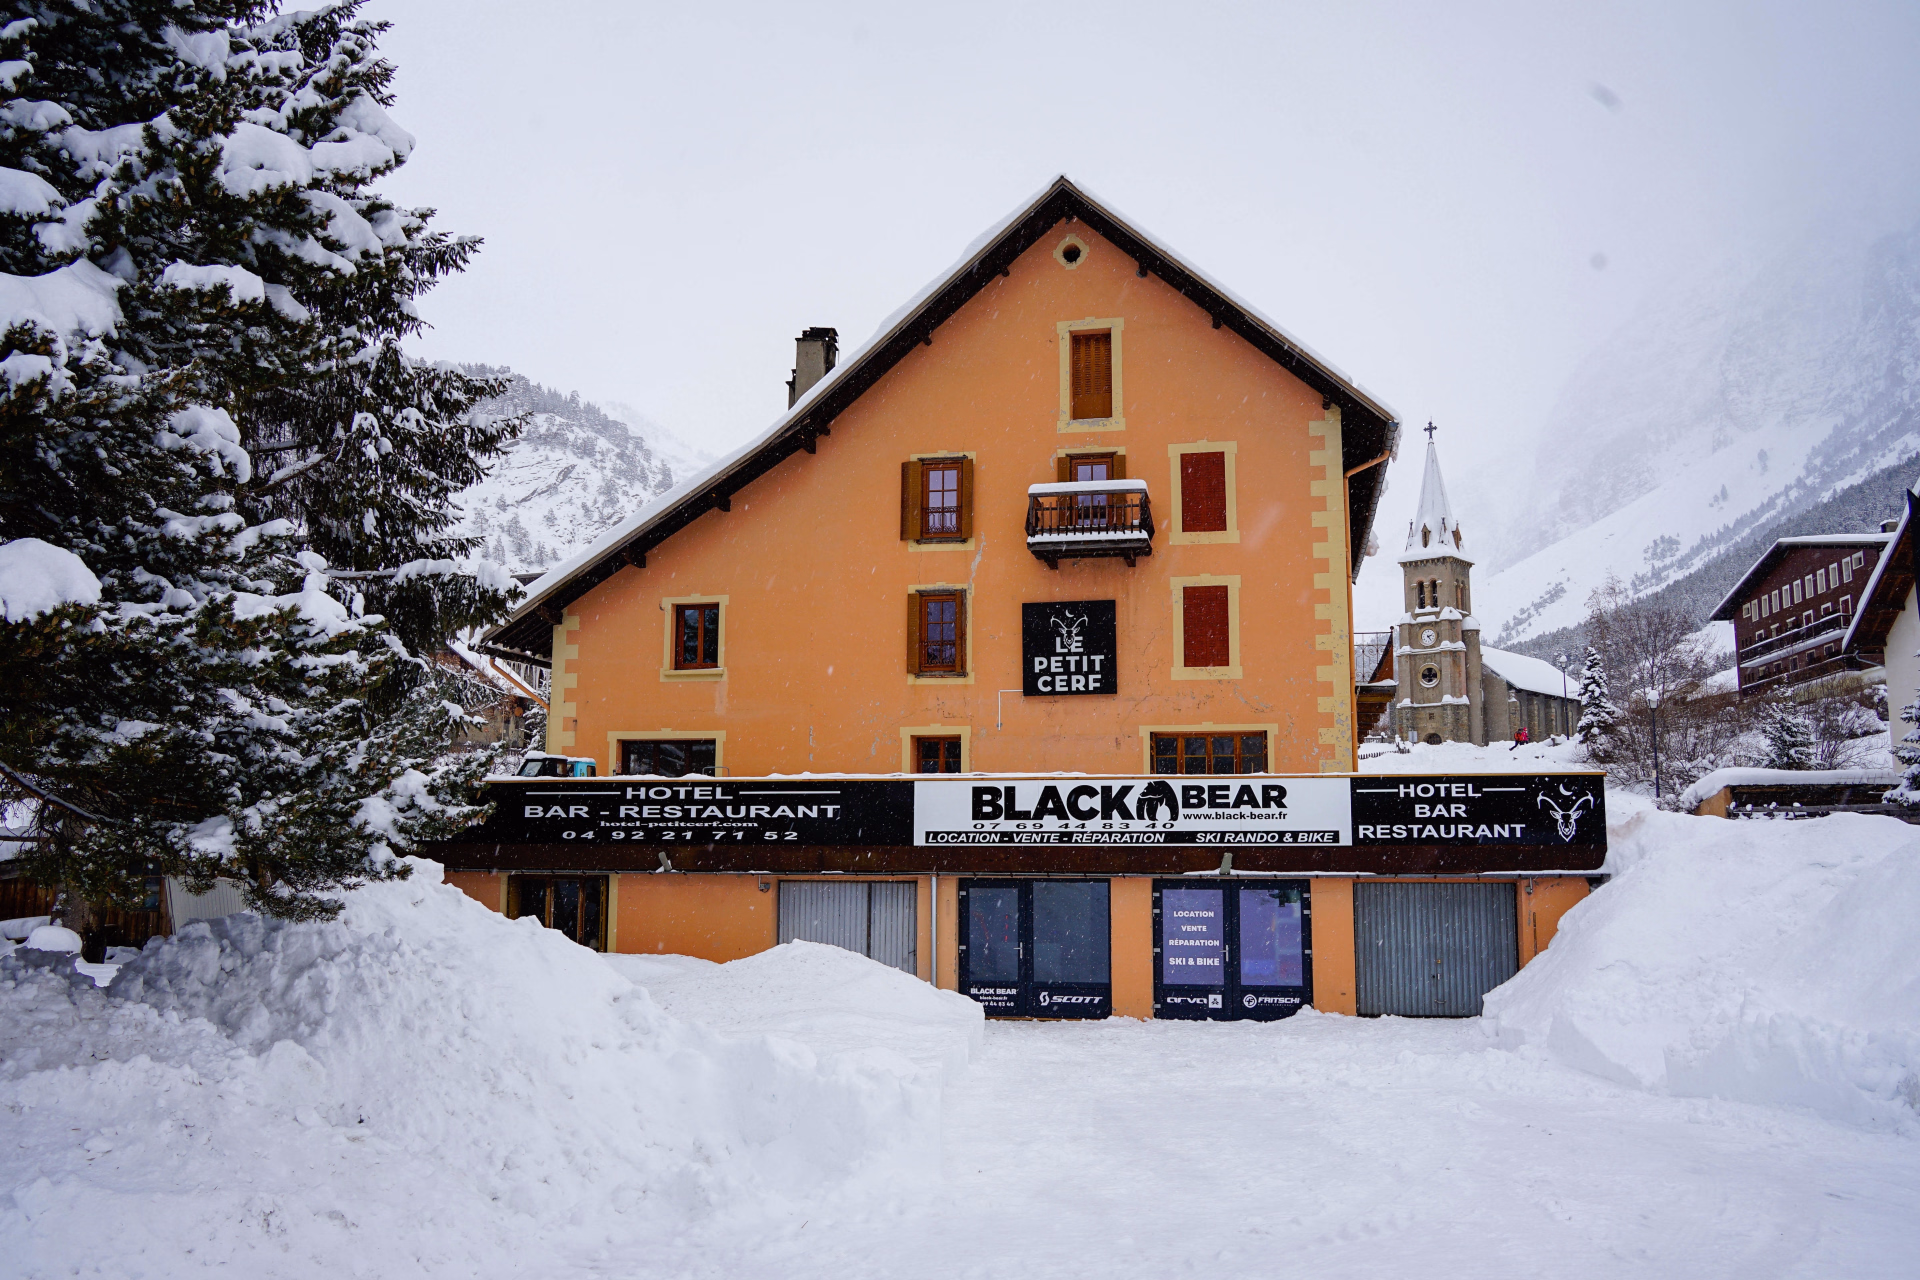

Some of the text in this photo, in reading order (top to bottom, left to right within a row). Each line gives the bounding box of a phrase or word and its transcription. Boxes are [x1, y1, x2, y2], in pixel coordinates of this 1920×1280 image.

[1055, 636, 1084, 653] LE
[1034, 654, 1105, 673] PETIT
[1037, 674, 1102, 692] CERF
[626, 786, 734, 800] HOTEL
[1399, 783, 1482, 798] HOTEL
[971, 784, 1288, 821] BLACK BEAR
[524, 805, 590, 818] BAR
[619, 805, 841, 819] RESTAURANT
[1183, 811, 1288, 820] www.black-bear.fr
[1414, 803, 1468, 818] BAR
[600, 820, 759, 829] hotel-petitcerf.com
[973, 822, 1175, 830] 07 69 44 83 40
[562, 830, 798, 840] 04 92 21 71 52
[1358, 823, 1526, 839] RESTAURANT
[928, 833, 1001, 843] LOCATION
[1013, 833, 1061, 843] VENTE
[1071, 831, 1166, 843] RÉPARATION
[1195, 832, 1335, 843] SKI RANDO & BIKE
[1173, 910, 1215, 918] LOCATION
[1168, 938, 1220, 946] RÉPARATION
[1169, 957, 1220, 966] SKI & BIKE
[1050, 995, 1104, 1004] SCOTT
[1257, 996, 1300, 1004] FRITSCHI
